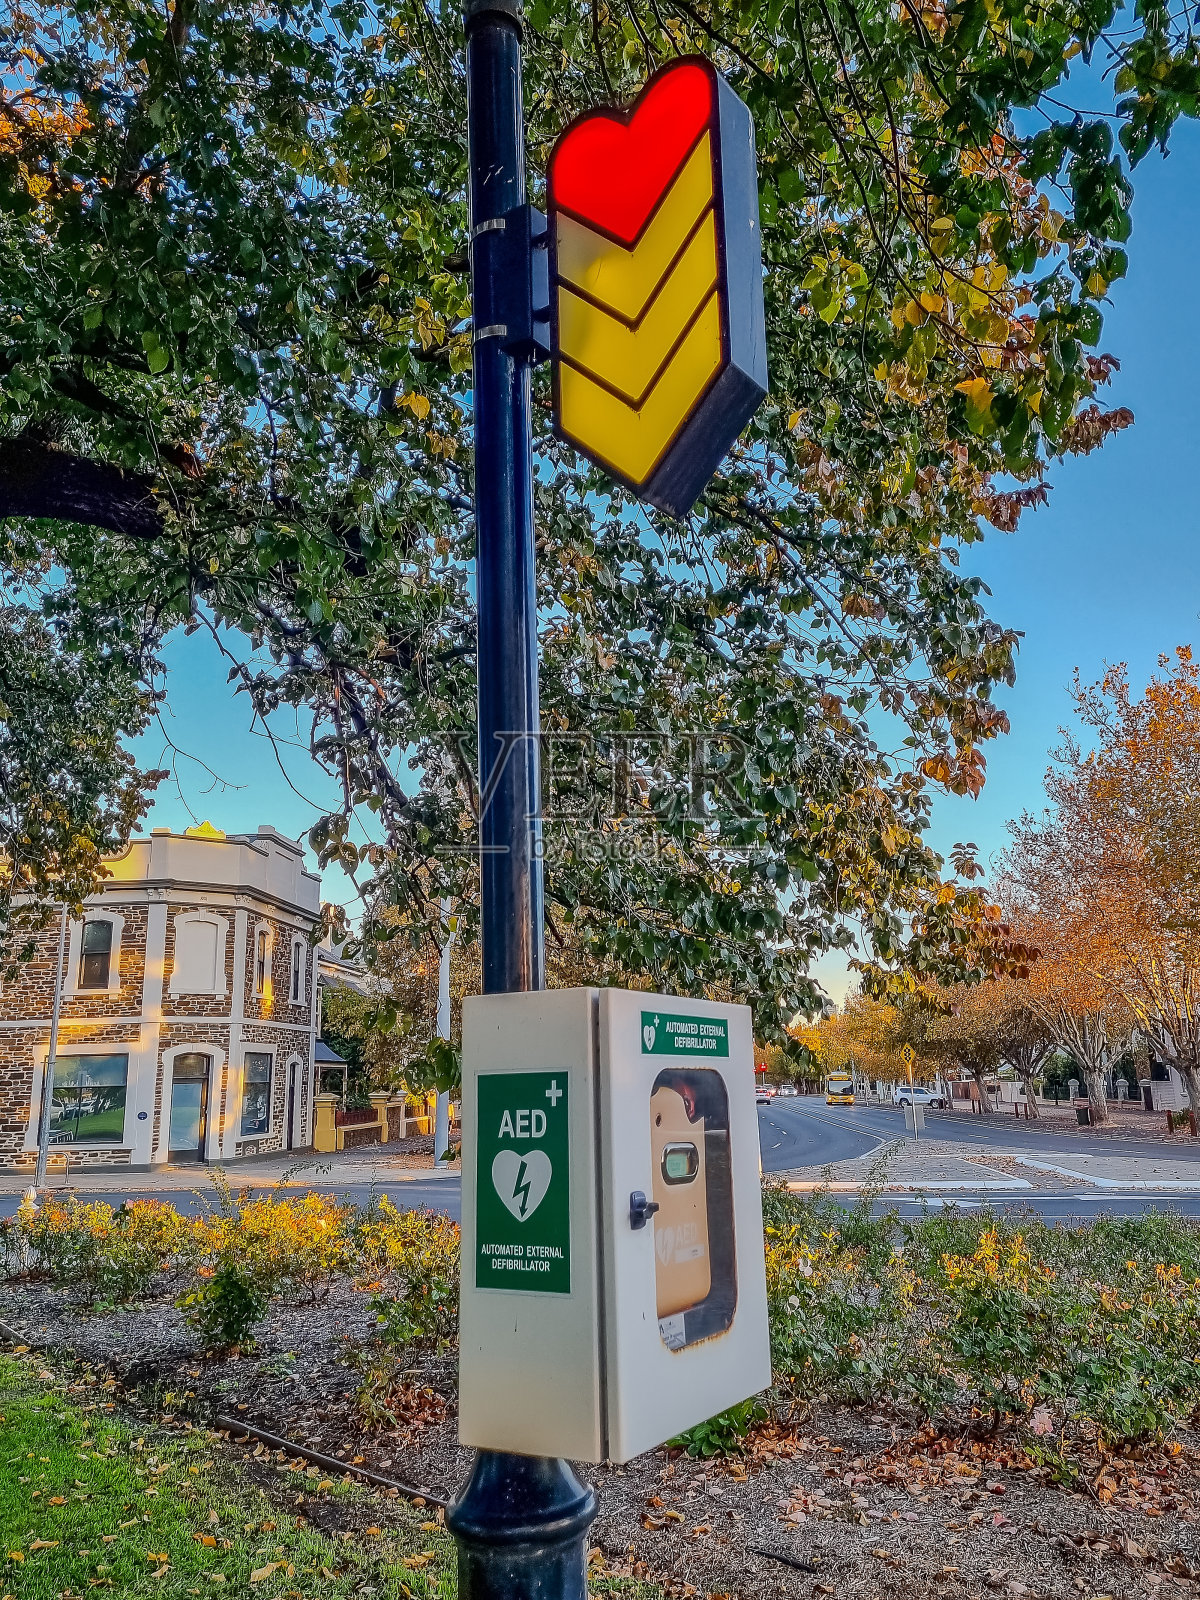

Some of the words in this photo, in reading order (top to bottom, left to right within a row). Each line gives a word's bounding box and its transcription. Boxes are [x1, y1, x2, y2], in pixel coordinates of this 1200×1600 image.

[665, 1021, 699, 1034] AUTOMATED
[699, 1024, 726, 1037] EXTERNAL
[674, 1036, 717, 1050] DEFIBRILLATOR
[498, 1109, 547, 1138] AED
[481, 1243, 524, 1256] AUTOMATED
[526, 1245, 564, 1259] EXTERNAL
[491, 1258, 551, 1272] DEFIBRILLATOR
